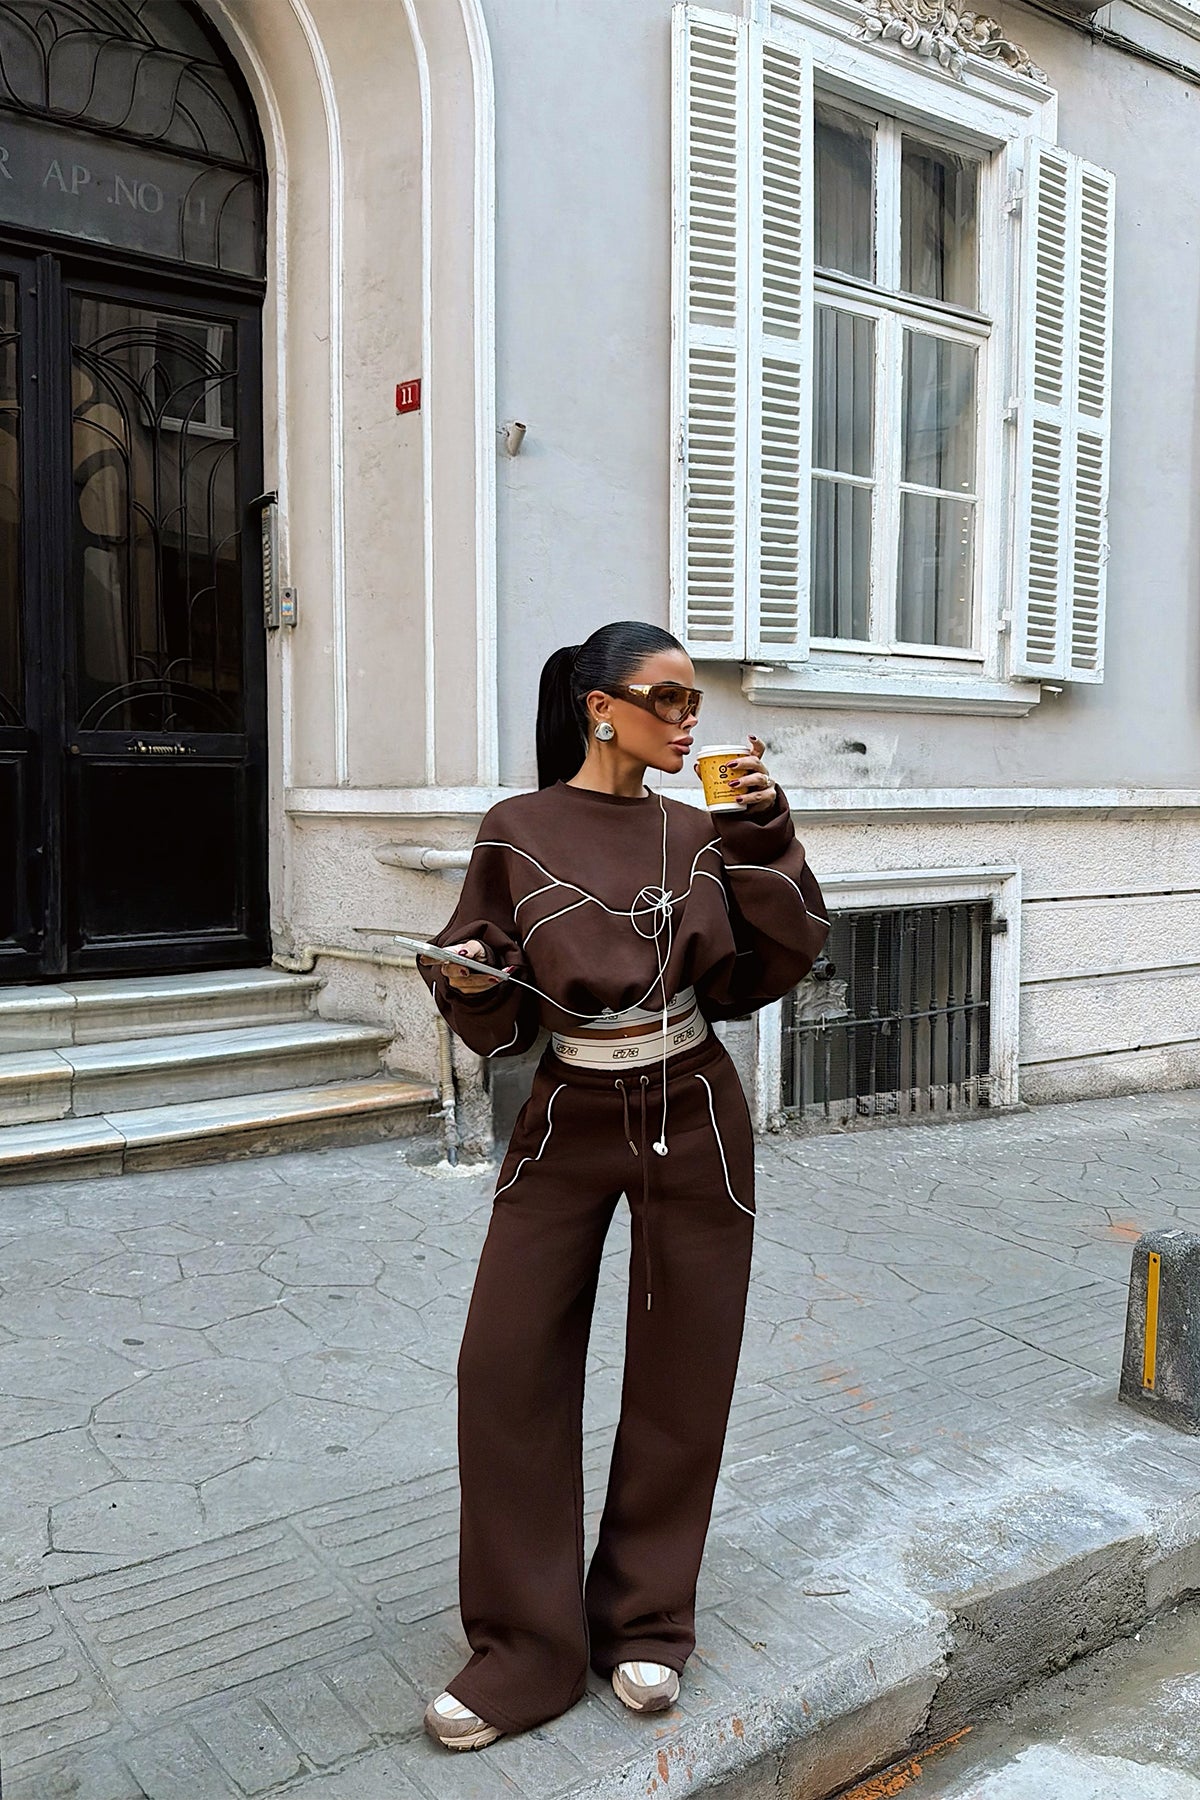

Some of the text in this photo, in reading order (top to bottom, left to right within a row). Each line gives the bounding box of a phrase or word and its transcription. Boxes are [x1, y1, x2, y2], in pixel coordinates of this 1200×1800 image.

[401, 387, 413, 405] 11
[673, 1027, 695, 1045] 573
[556, 1043, 578, 1056] 573
[613, 1047, 639, 1059] 573
